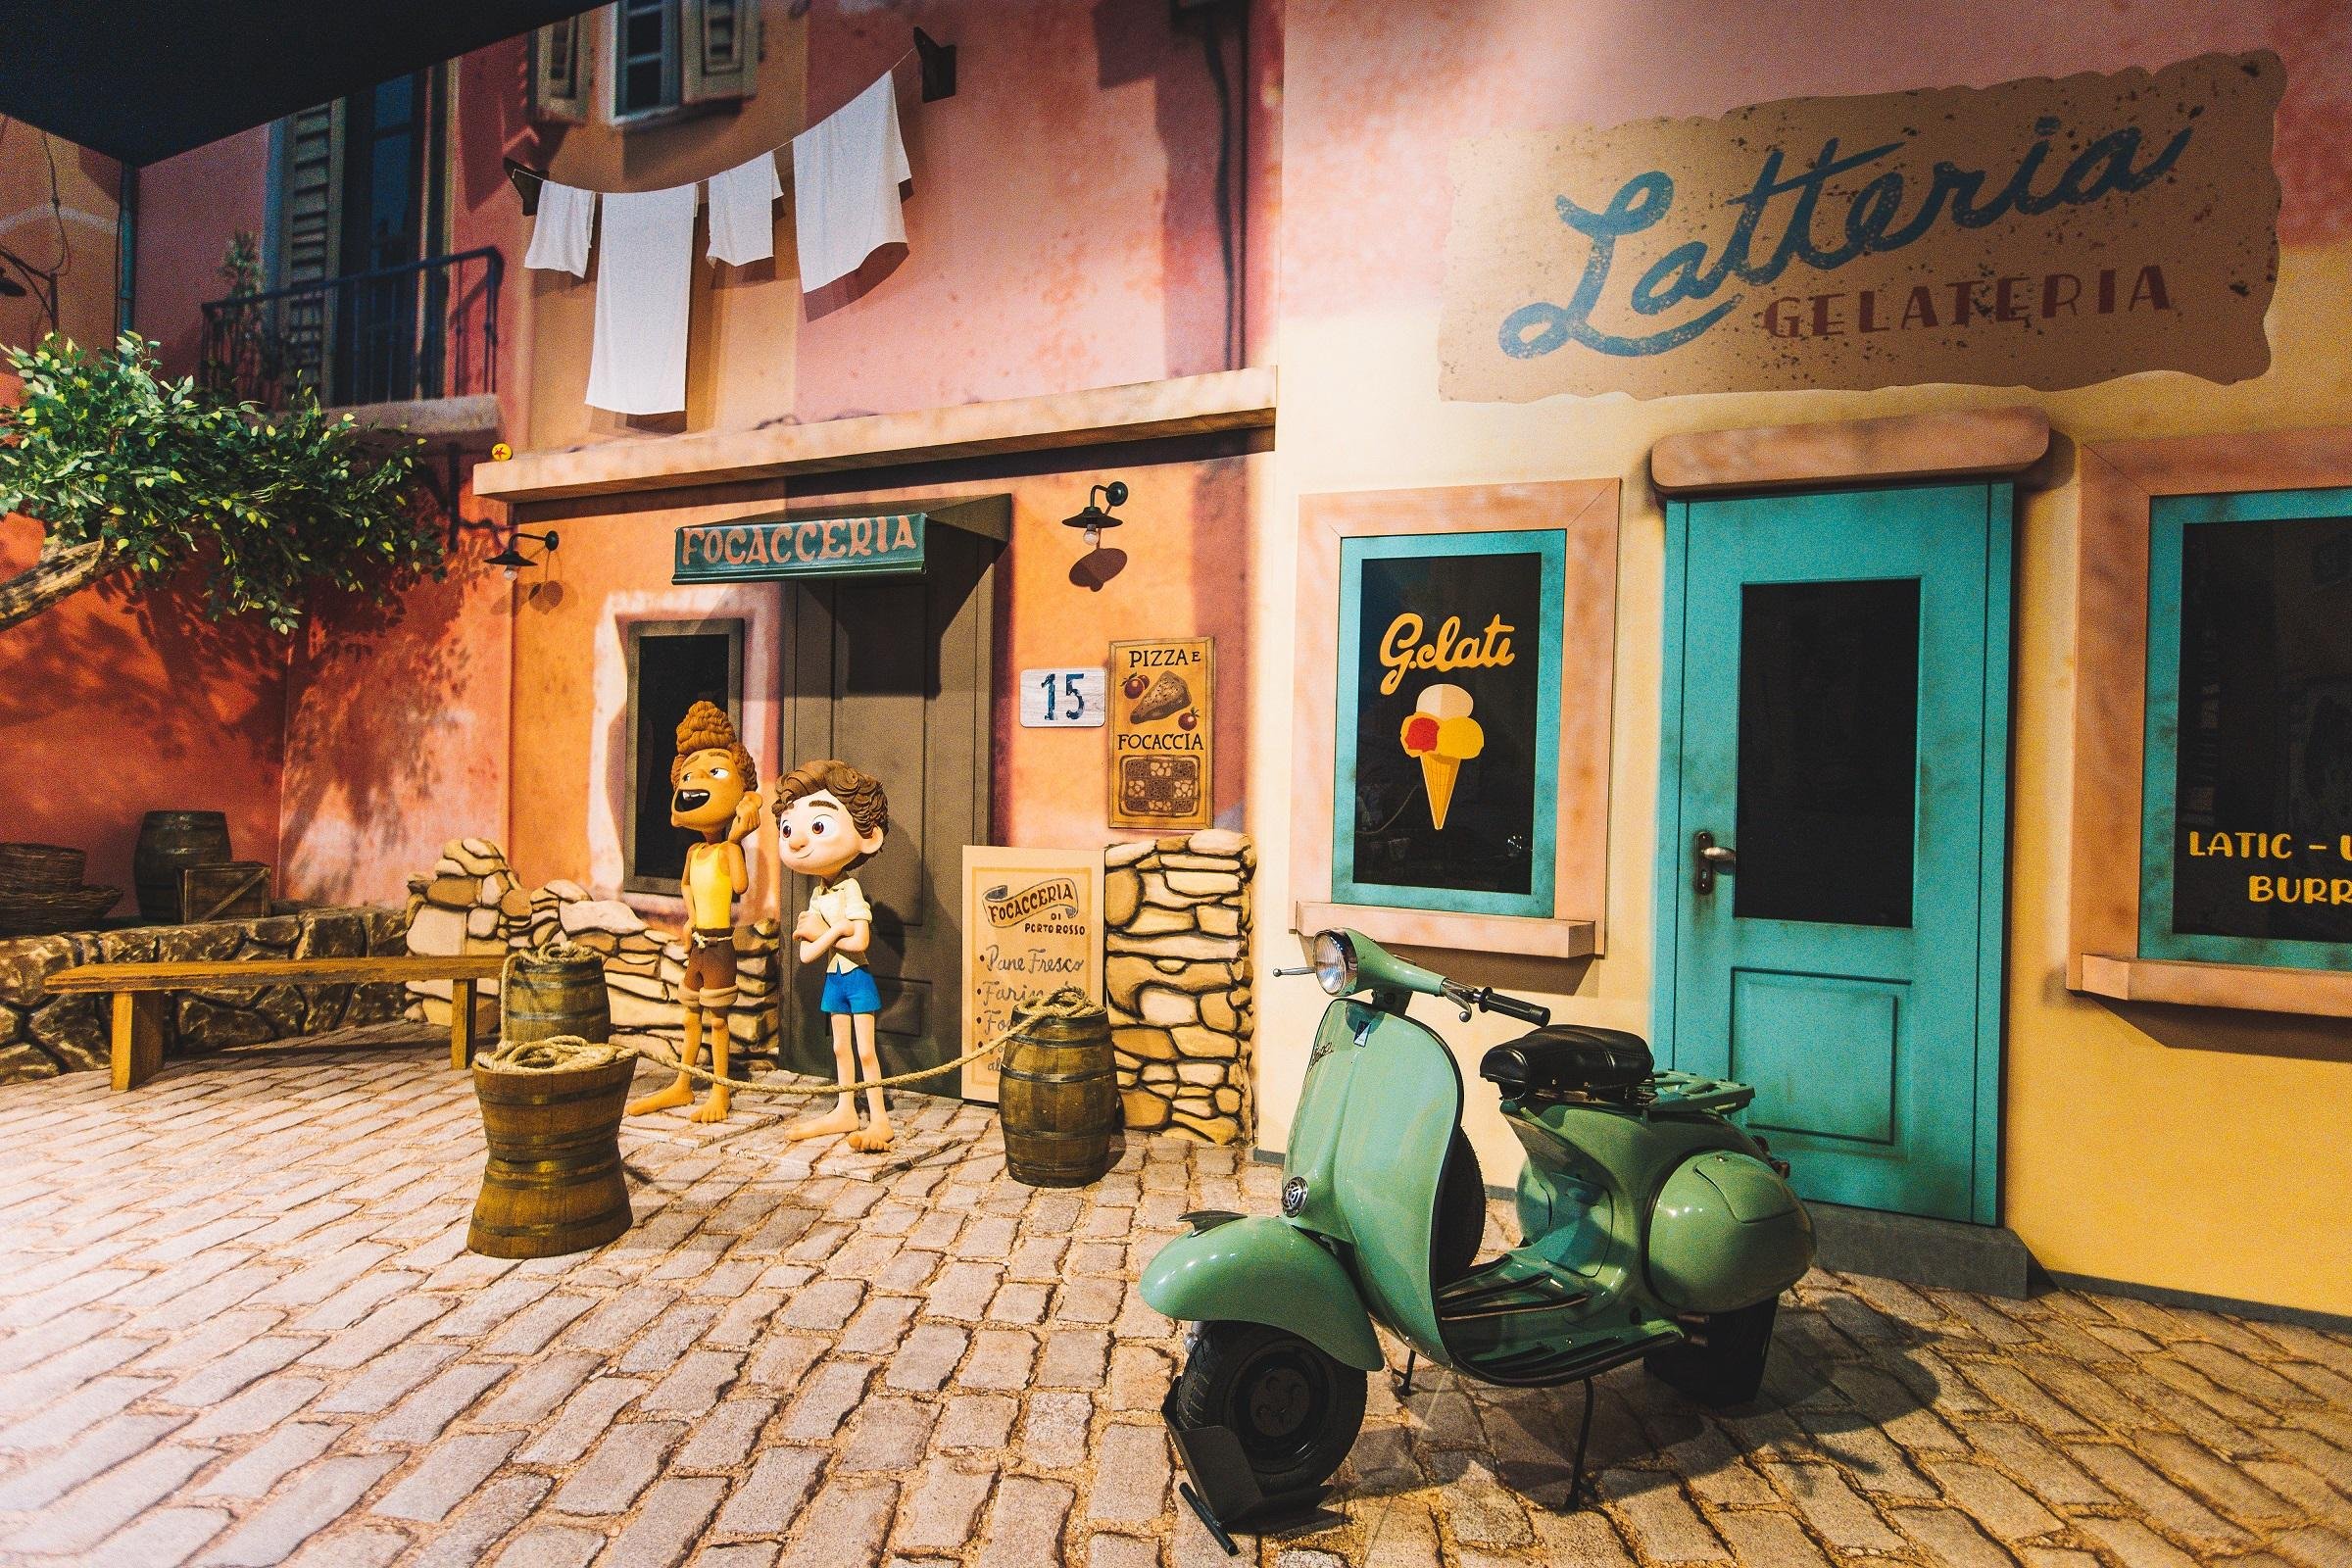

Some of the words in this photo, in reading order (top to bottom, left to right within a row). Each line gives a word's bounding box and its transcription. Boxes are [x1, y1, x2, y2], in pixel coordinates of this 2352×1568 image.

[1498, 116, 2195, 360] Latteria
[1765, 265, 2172, 340] GELATERIA
[682, 514, 917, 565] FOCACCERIA
[1129, 649, 1189, 668] PIZZA
[1192, 651, 1201, 662] E
[1379, 612, 1515, 696] Gelati
[1041, 672, 1085, 721] 15
[1117, 733, 1203, 751] FOCACCIA
[2189, 831, 2292, 859] LATIC
[989, 884, 1074, 923] FOCACCERIA
[986, 945, 1026, 971] Pane
[1027, 949, 1084, 974] Fresco
